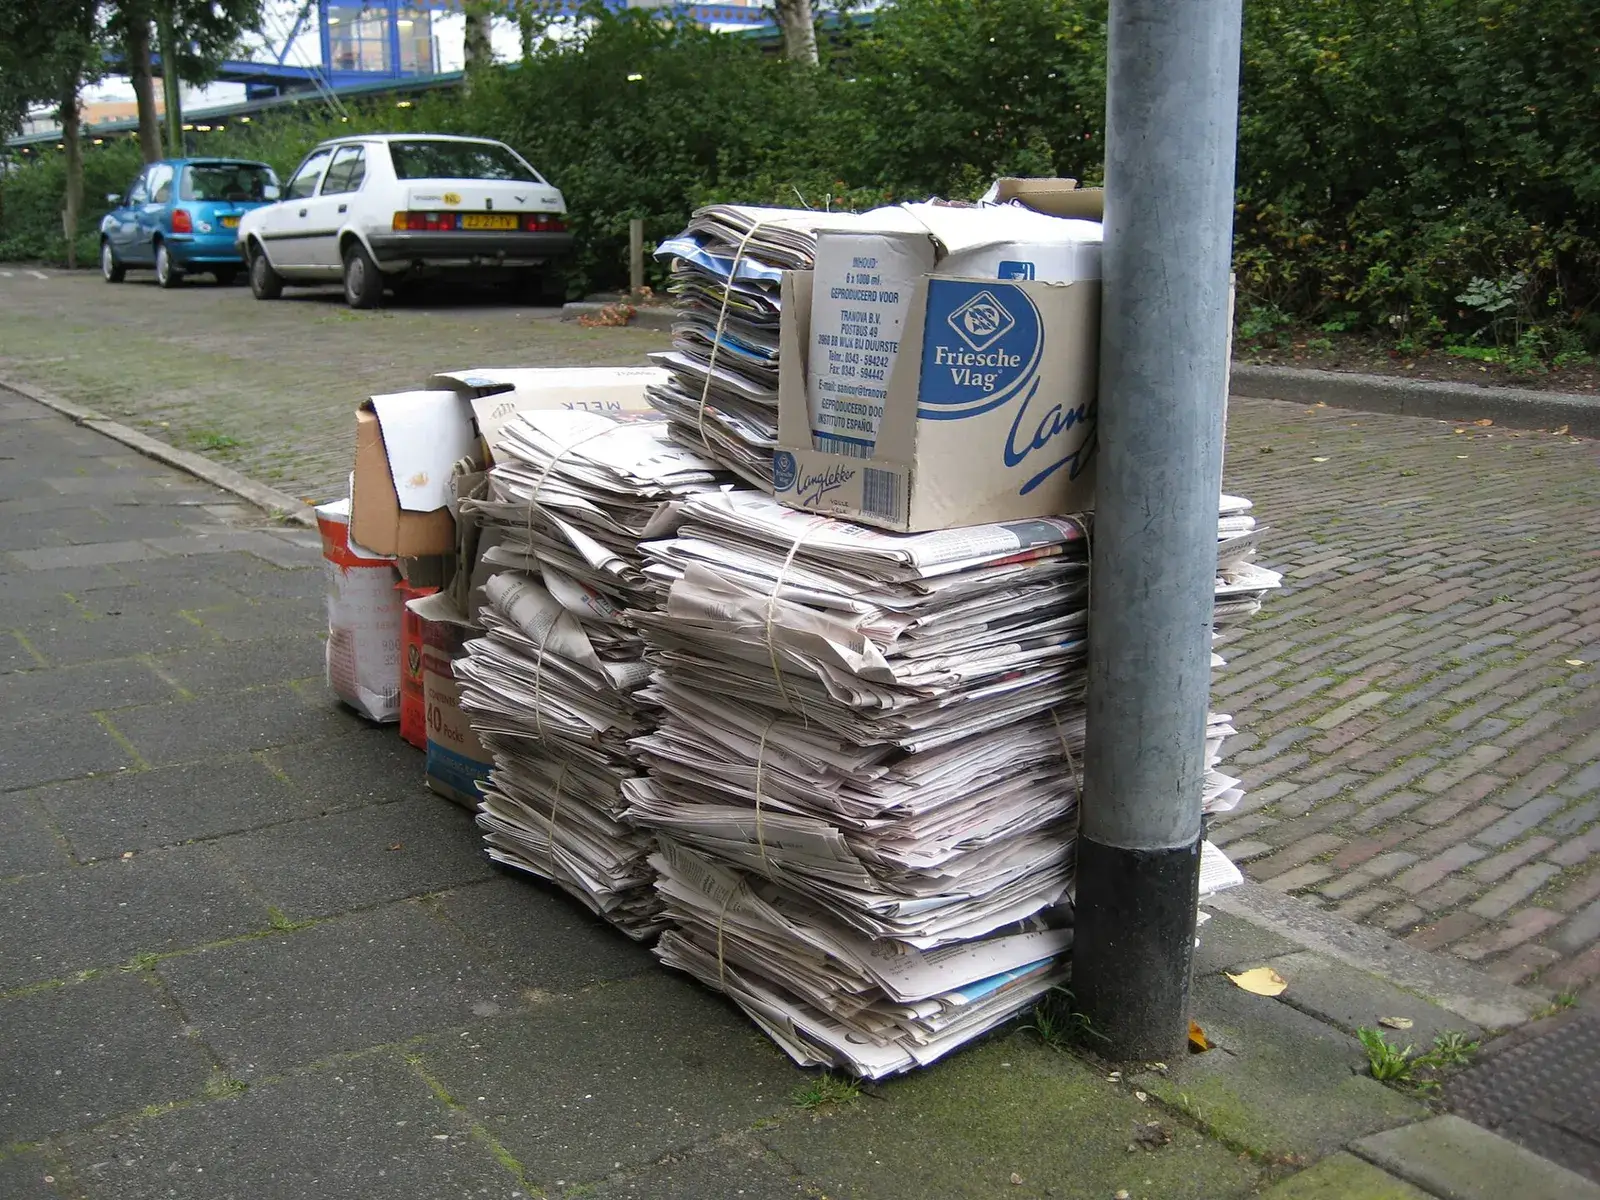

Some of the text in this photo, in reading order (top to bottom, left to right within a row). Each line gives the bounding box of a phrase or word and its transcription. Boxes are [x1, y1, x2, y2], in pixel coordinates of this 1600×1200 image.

[846, 272, 850, 284] 6
[856, 273, 870, 285] 1000
[831, 287, 899, 303] GEPRODUCEERD VOOR
[841, 310, 881, 325] TRANOVA B.V.
[841, 323, 878, 338] POSTBUS 49
[855, 338, 864, 350] BIJ
[864, 340, 898, 353] DUURSTE
[845, 352, 859, 364] 0343
[864, 355, 889, 368] 594242
[934, 346, 1021, 367] Friesche
[841, 365, 855, 377] 0343
[860, 367, 885, 381] 594442
[950, 368, 998, 392] Vlag
[818, 379, 836, 392] E-mail:
[561, 401, 621, 411] MELK
[821, 398, 867, 416] GEPRODUCEERD
[818, 413, 846, 428] INSTITUTO
[796, 464, 856, 507] Langlekker
[426, 702, 442, 733] 40
